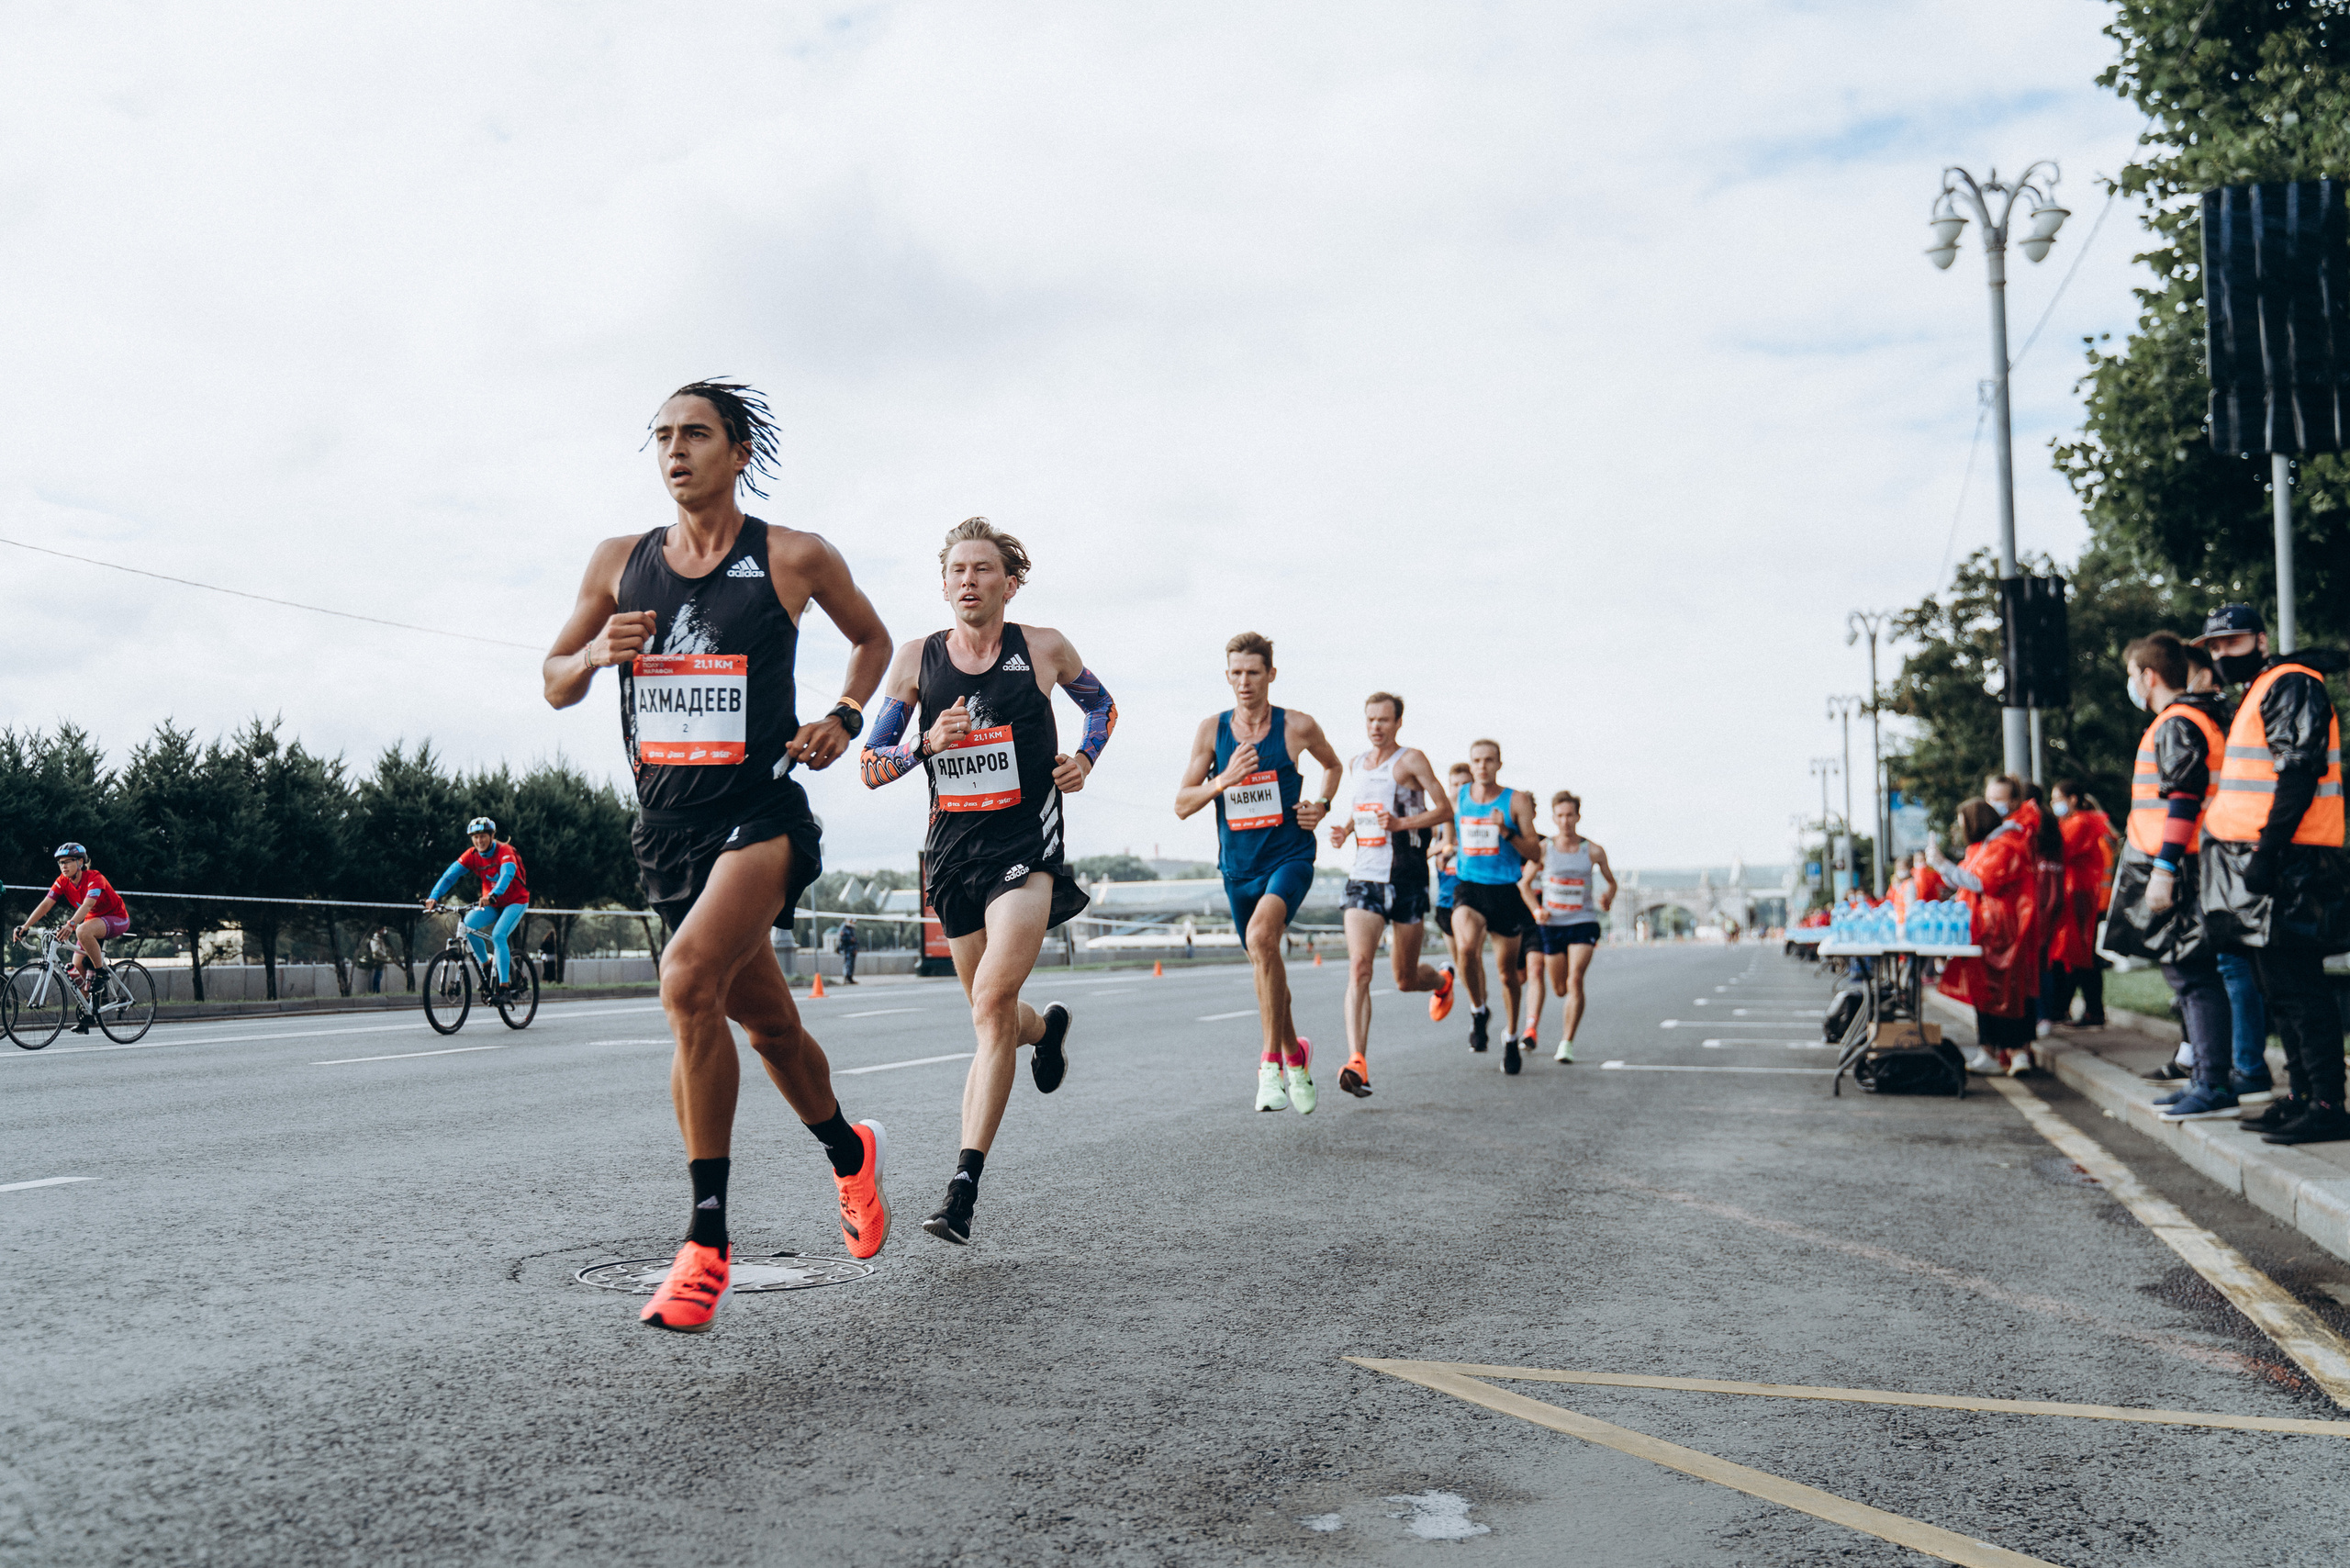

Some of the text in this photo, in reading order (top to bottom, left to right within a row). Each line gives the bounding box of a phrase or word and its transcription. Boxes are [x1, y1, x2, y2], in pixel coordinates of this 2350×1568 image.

[726, 569, 765, 577] adidas
[694, 659, 712, 669] 21,1
[639, 688, 742, 717] АХМАДЕЕВ
[683, 723, 688, 733] 2
[973, 733, 988, 742] 21,1
[937, 751, 1009, 779] ЯДГАРОВ
[1230, 789, 1272, 805] ЧАВКИН
[1004, 866, 1030, 882] adidas
